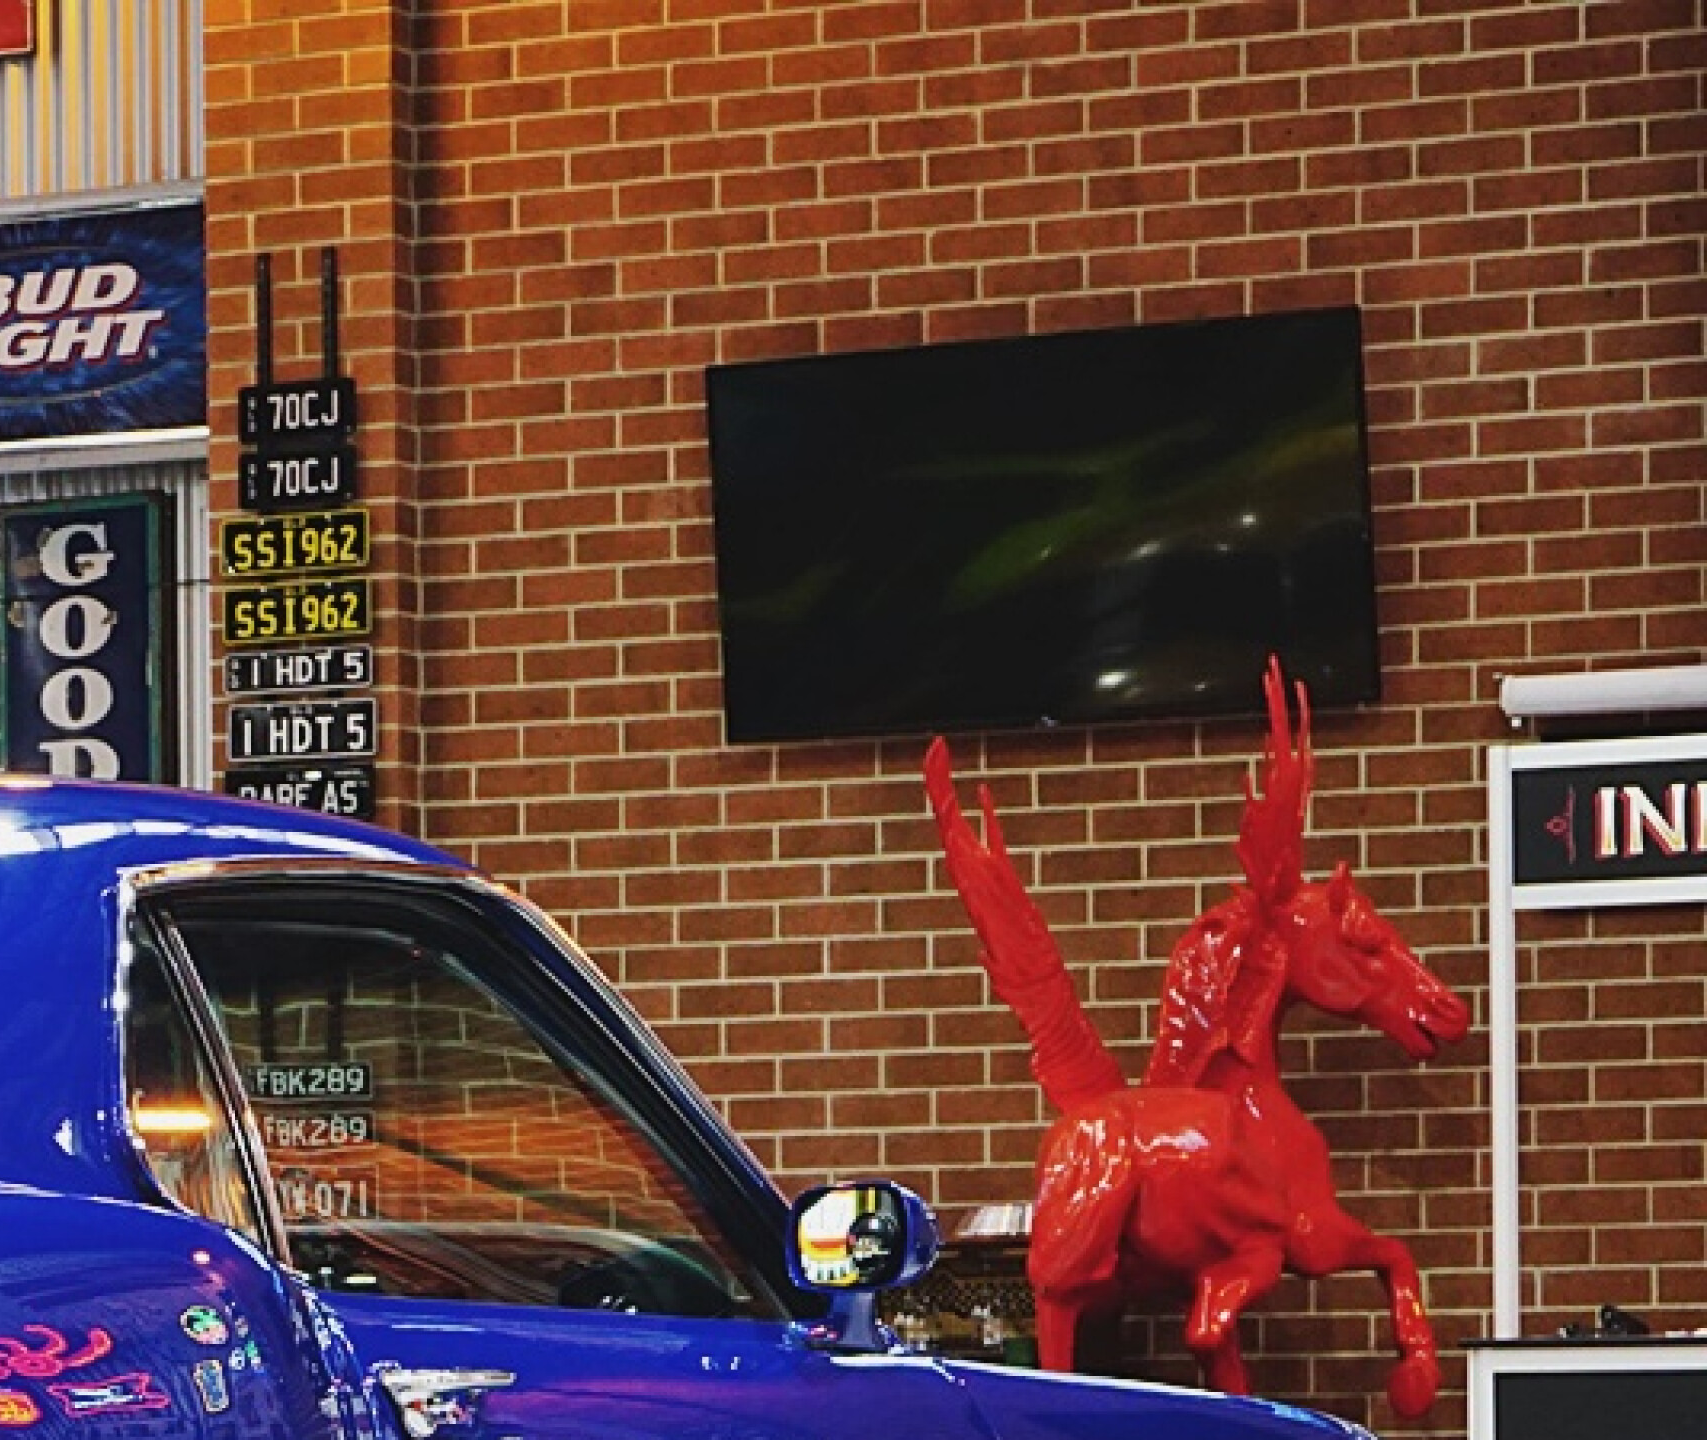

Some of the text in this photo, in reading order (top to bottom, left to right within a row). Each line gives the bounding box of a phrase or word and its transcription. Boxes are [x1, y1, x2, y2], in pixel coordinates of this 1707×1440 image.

[267, 389, 339, 430] 70CJ
[267, 457, 339, 497] 70CJ
[234, 524, 358, 571] SSI962
[235, 592, 358, 638] SSI962
[275, 653, 333, 684] HDT
[343, 652, 364, 680] 5
[269, 715, 334, 752] HDT
[345, 713, 367, 750] 5
[322, 781, 358, 814] AS
